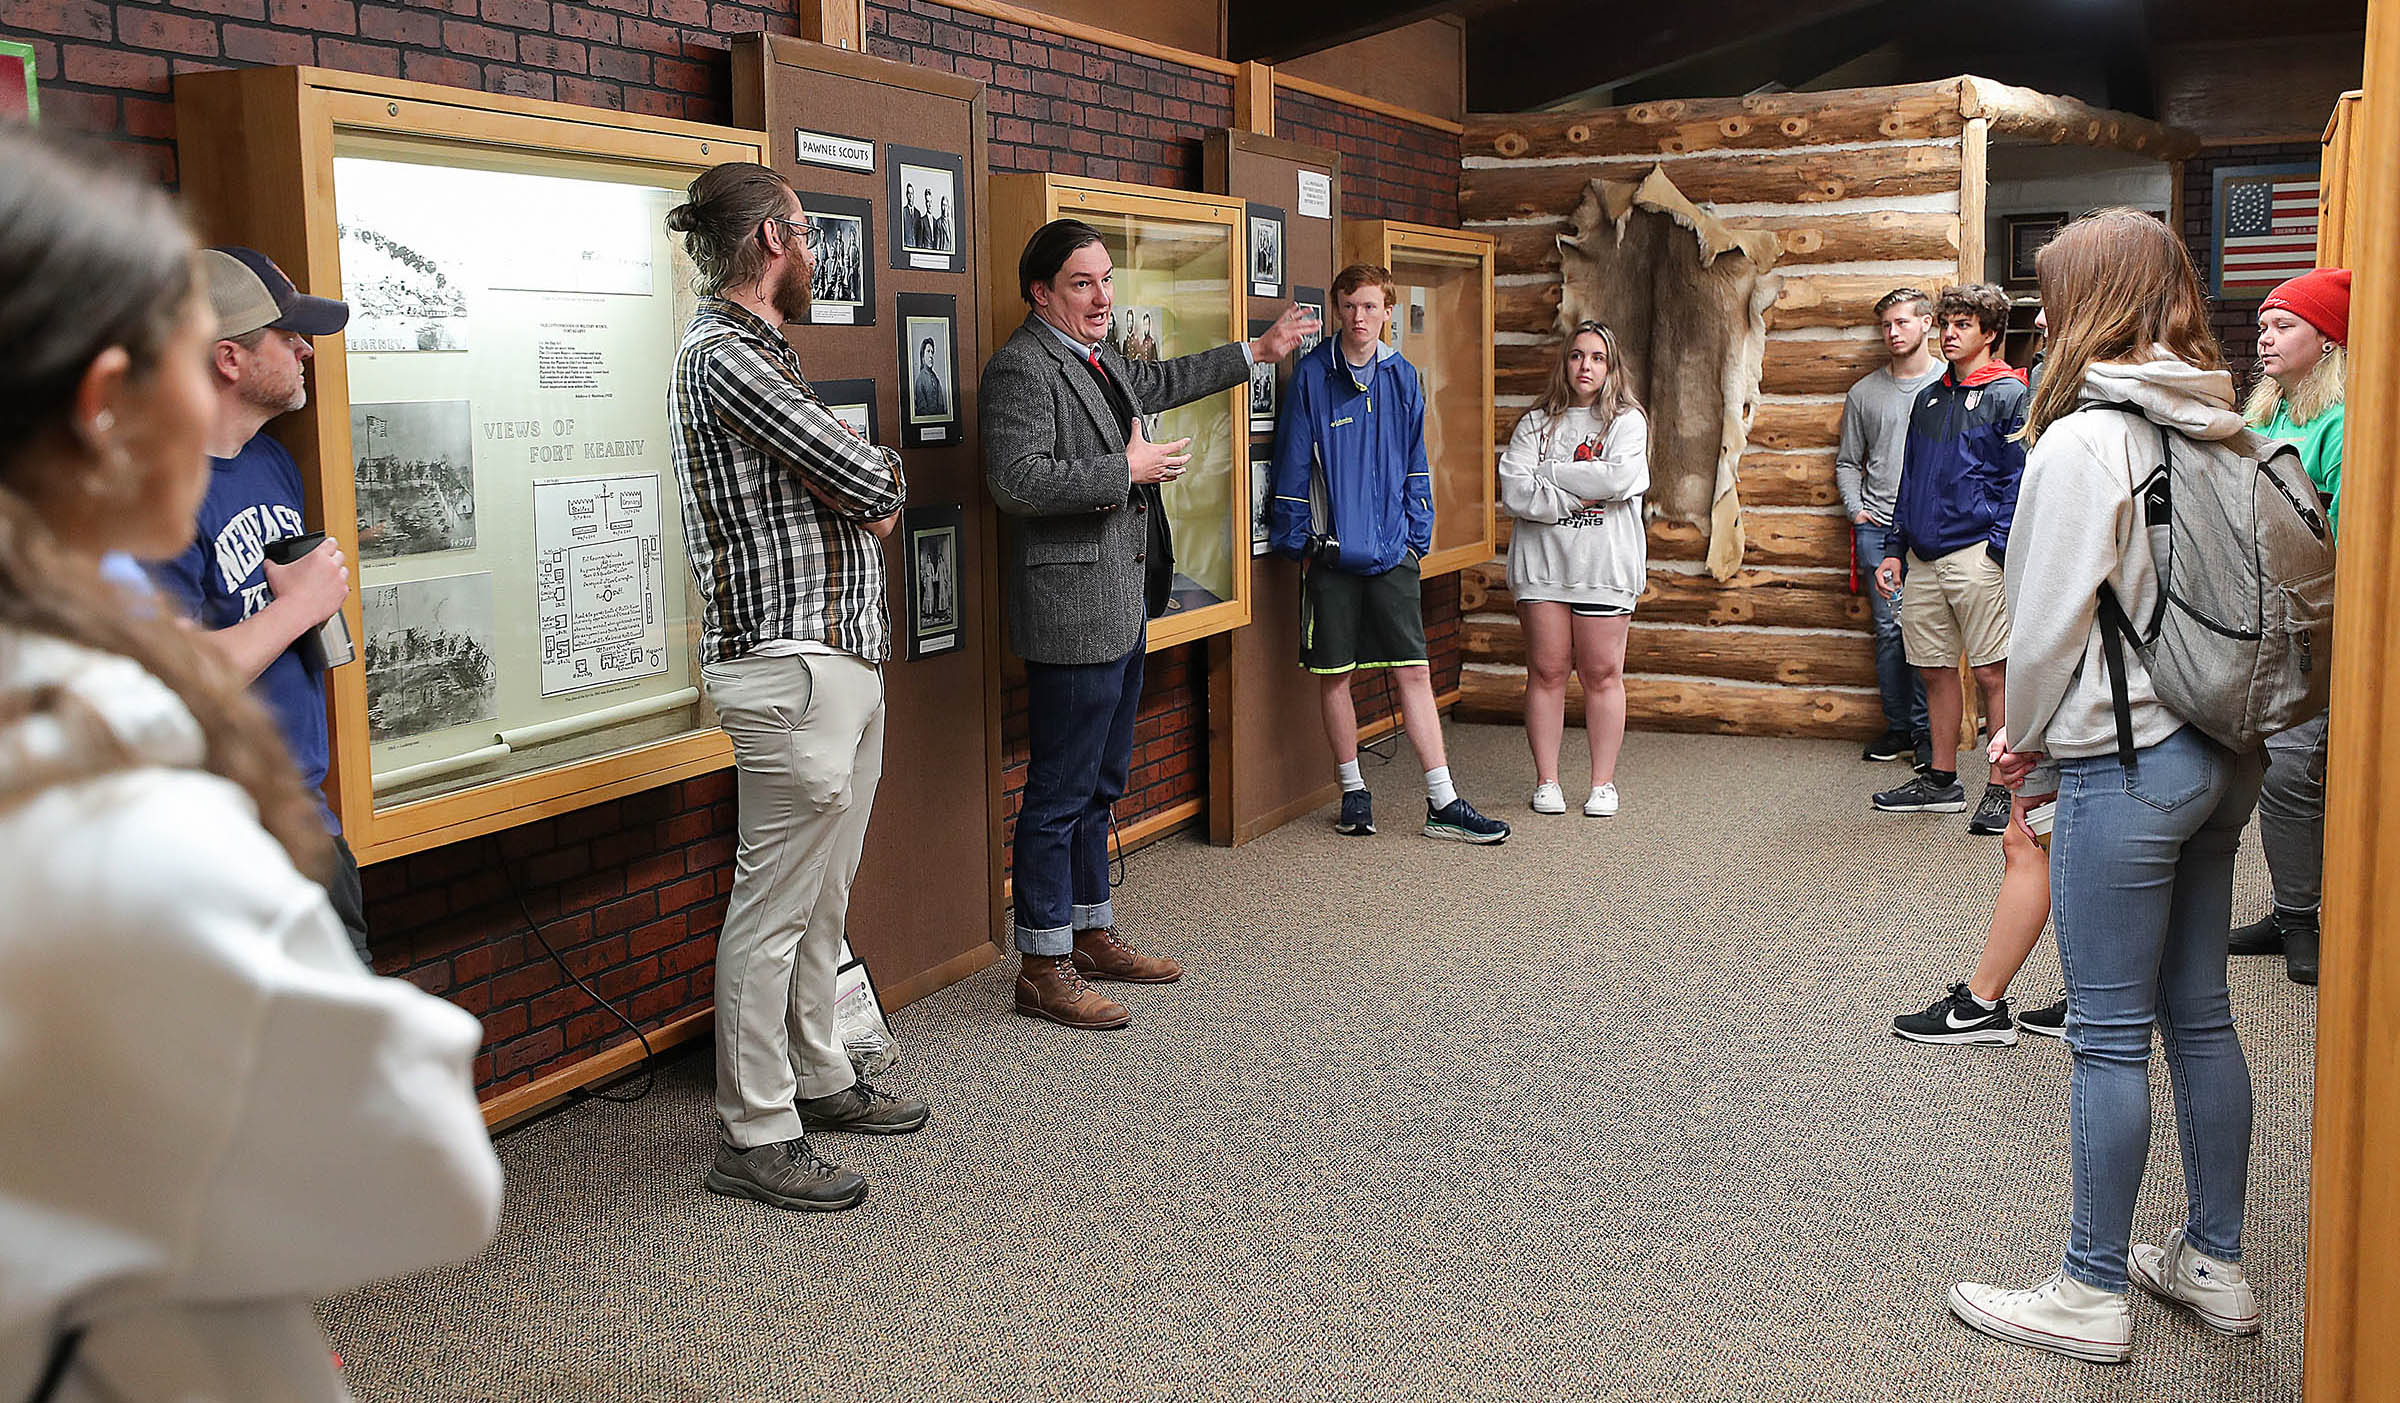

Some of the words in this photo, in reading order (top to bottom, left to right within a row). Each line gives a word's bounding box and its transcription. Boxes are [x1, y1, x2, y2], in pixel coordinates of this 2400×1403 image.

[803, 141, 836, 157] PAWNEE
[838, 146, 869, 161] SCOUTS
[483, 420, 541, 440] VIEWS
[552, 418, 576, 437] OF
[529, 444, 574, 463] FORT
[584, 439, 645, 460] KEARNY
